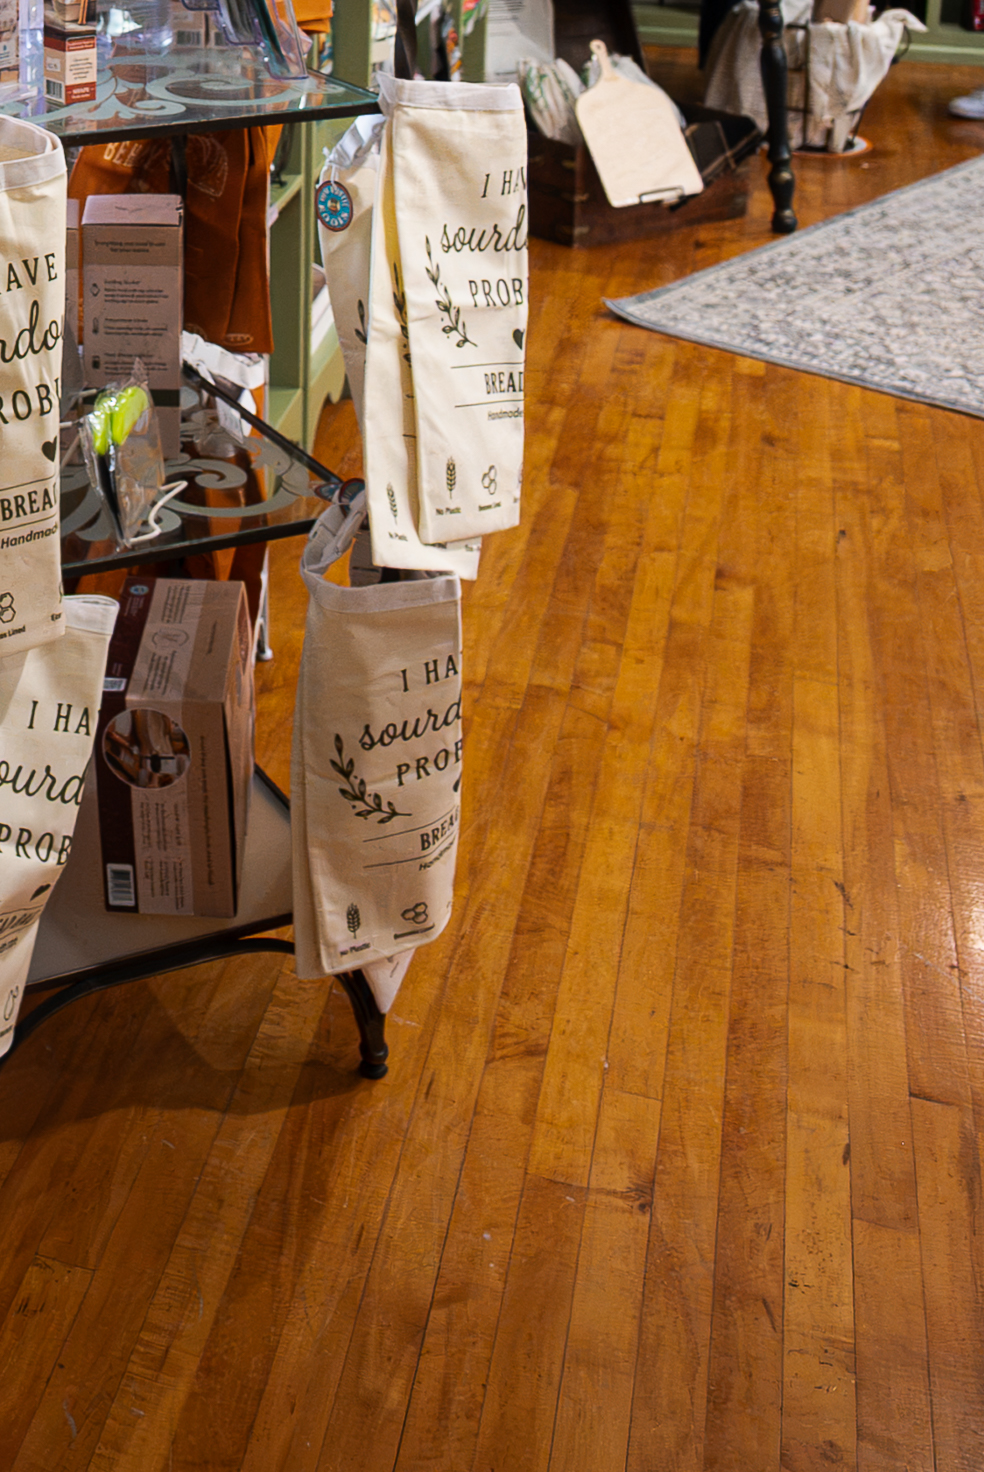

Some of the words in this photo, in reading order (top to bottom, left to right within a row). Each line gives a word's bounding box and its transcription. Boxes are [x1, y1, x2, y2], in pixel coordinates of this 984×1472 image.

[481, 173, 490, 198] I
[440, 204, 528, 254] sourd
[468, 278, 524, 308] PROB
[400, 668, 409, 693] I
[424, 654, 458, 686] HA
[27, 700, 38, 730] I
[53, 702, 91, 737] HA
